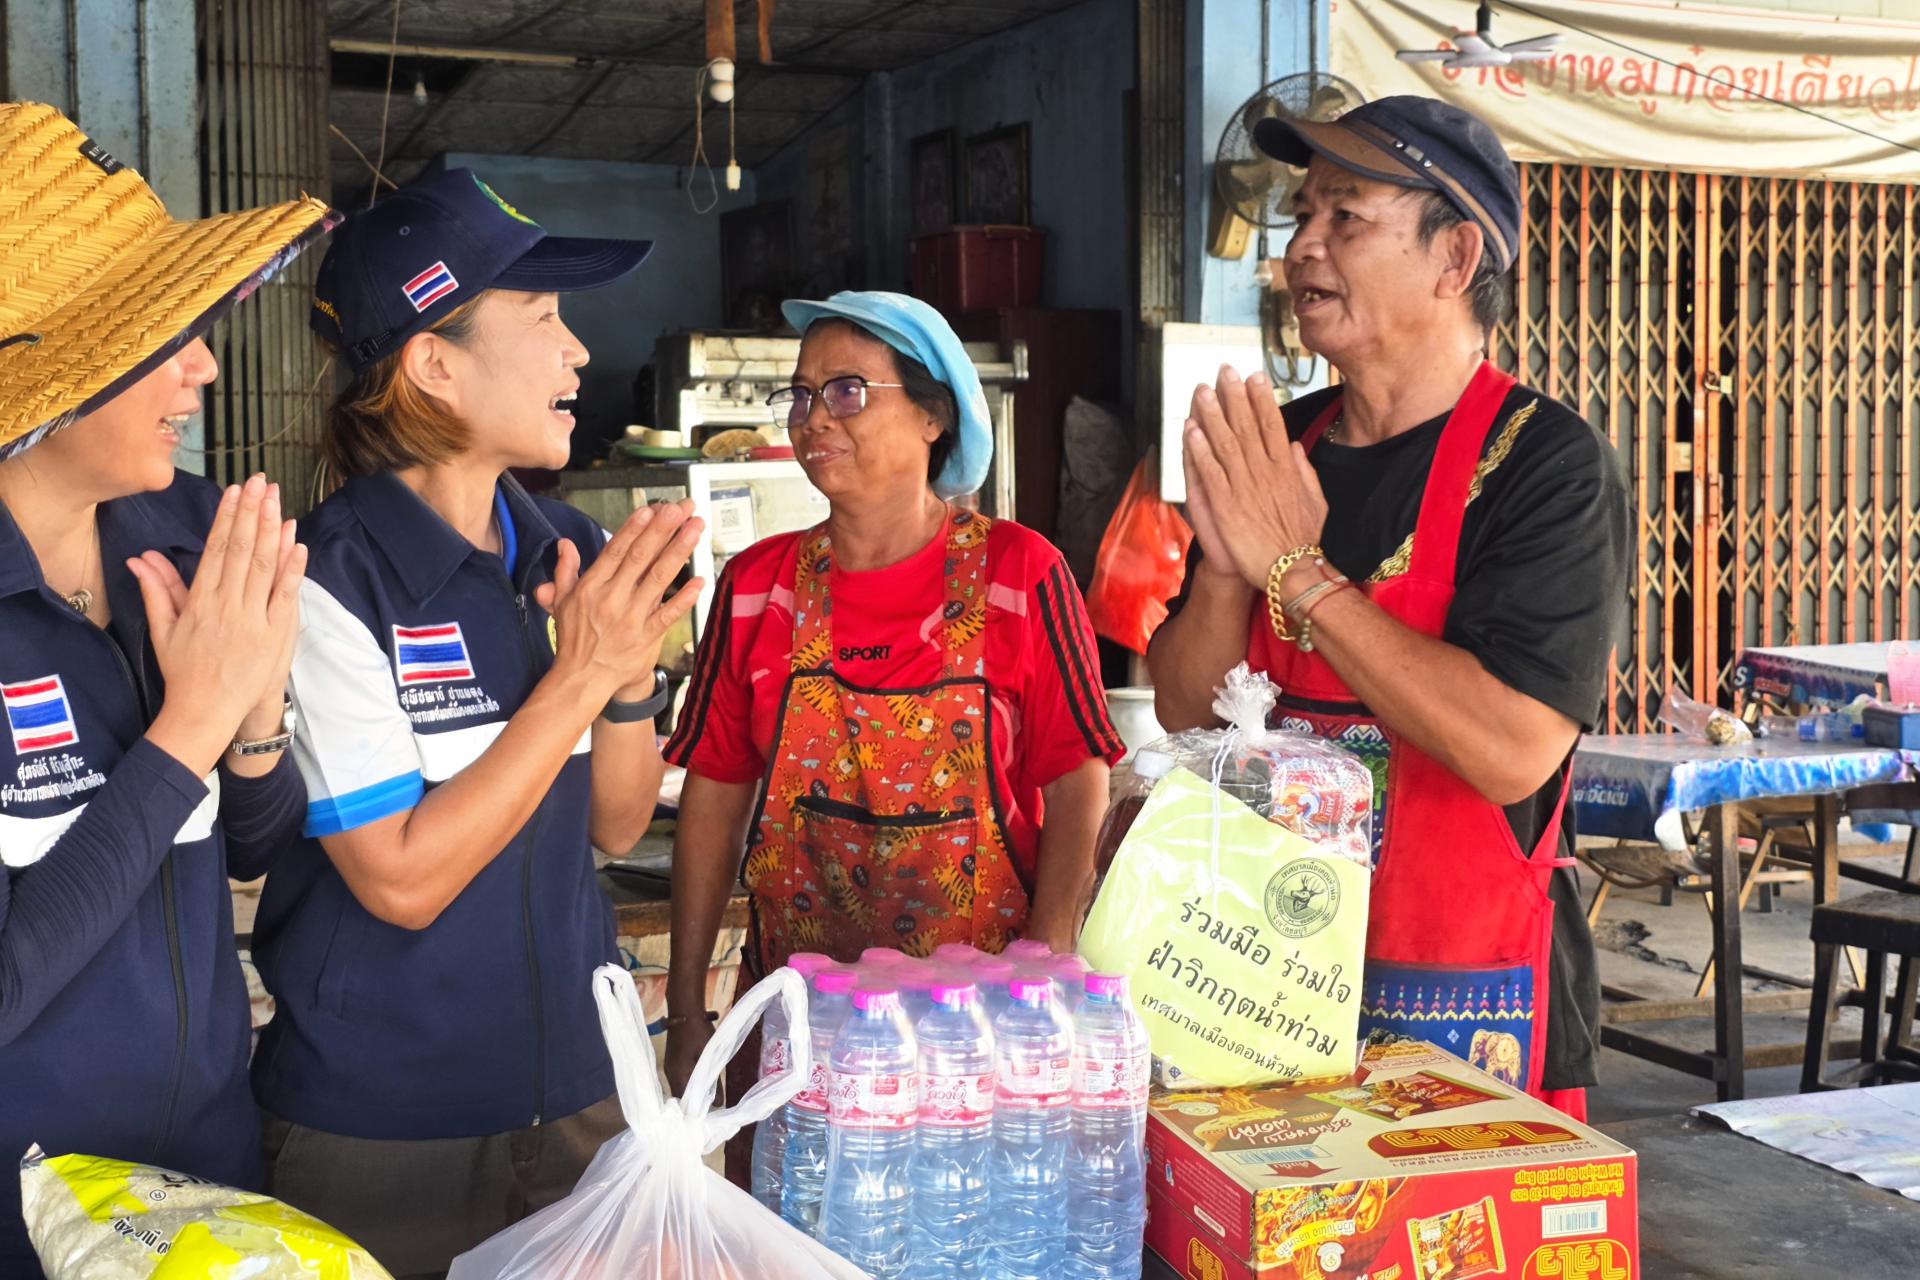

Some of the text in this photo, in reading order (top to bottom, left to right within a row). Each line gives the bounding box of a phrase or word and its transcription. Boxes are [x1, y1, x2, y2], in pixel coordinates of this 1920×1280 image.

[838, 645, 893, 662] SPORT
[1177, 896, 1271, 967] ร่วมมือ
[1282, 949, 1352, 1005] ร่วมใจ
[1146, 938, 1339, 1058] ฝ่าวิกฤตน้ำท่วม
[1514, 1164, 1624, 1185] Net Weight 60 g x 30 Bags
[1530, 1187, 1542, 1201] 30
[1543, 1187, 1550, 1198] x
[1570, 1184, 1581, 1198] 60
